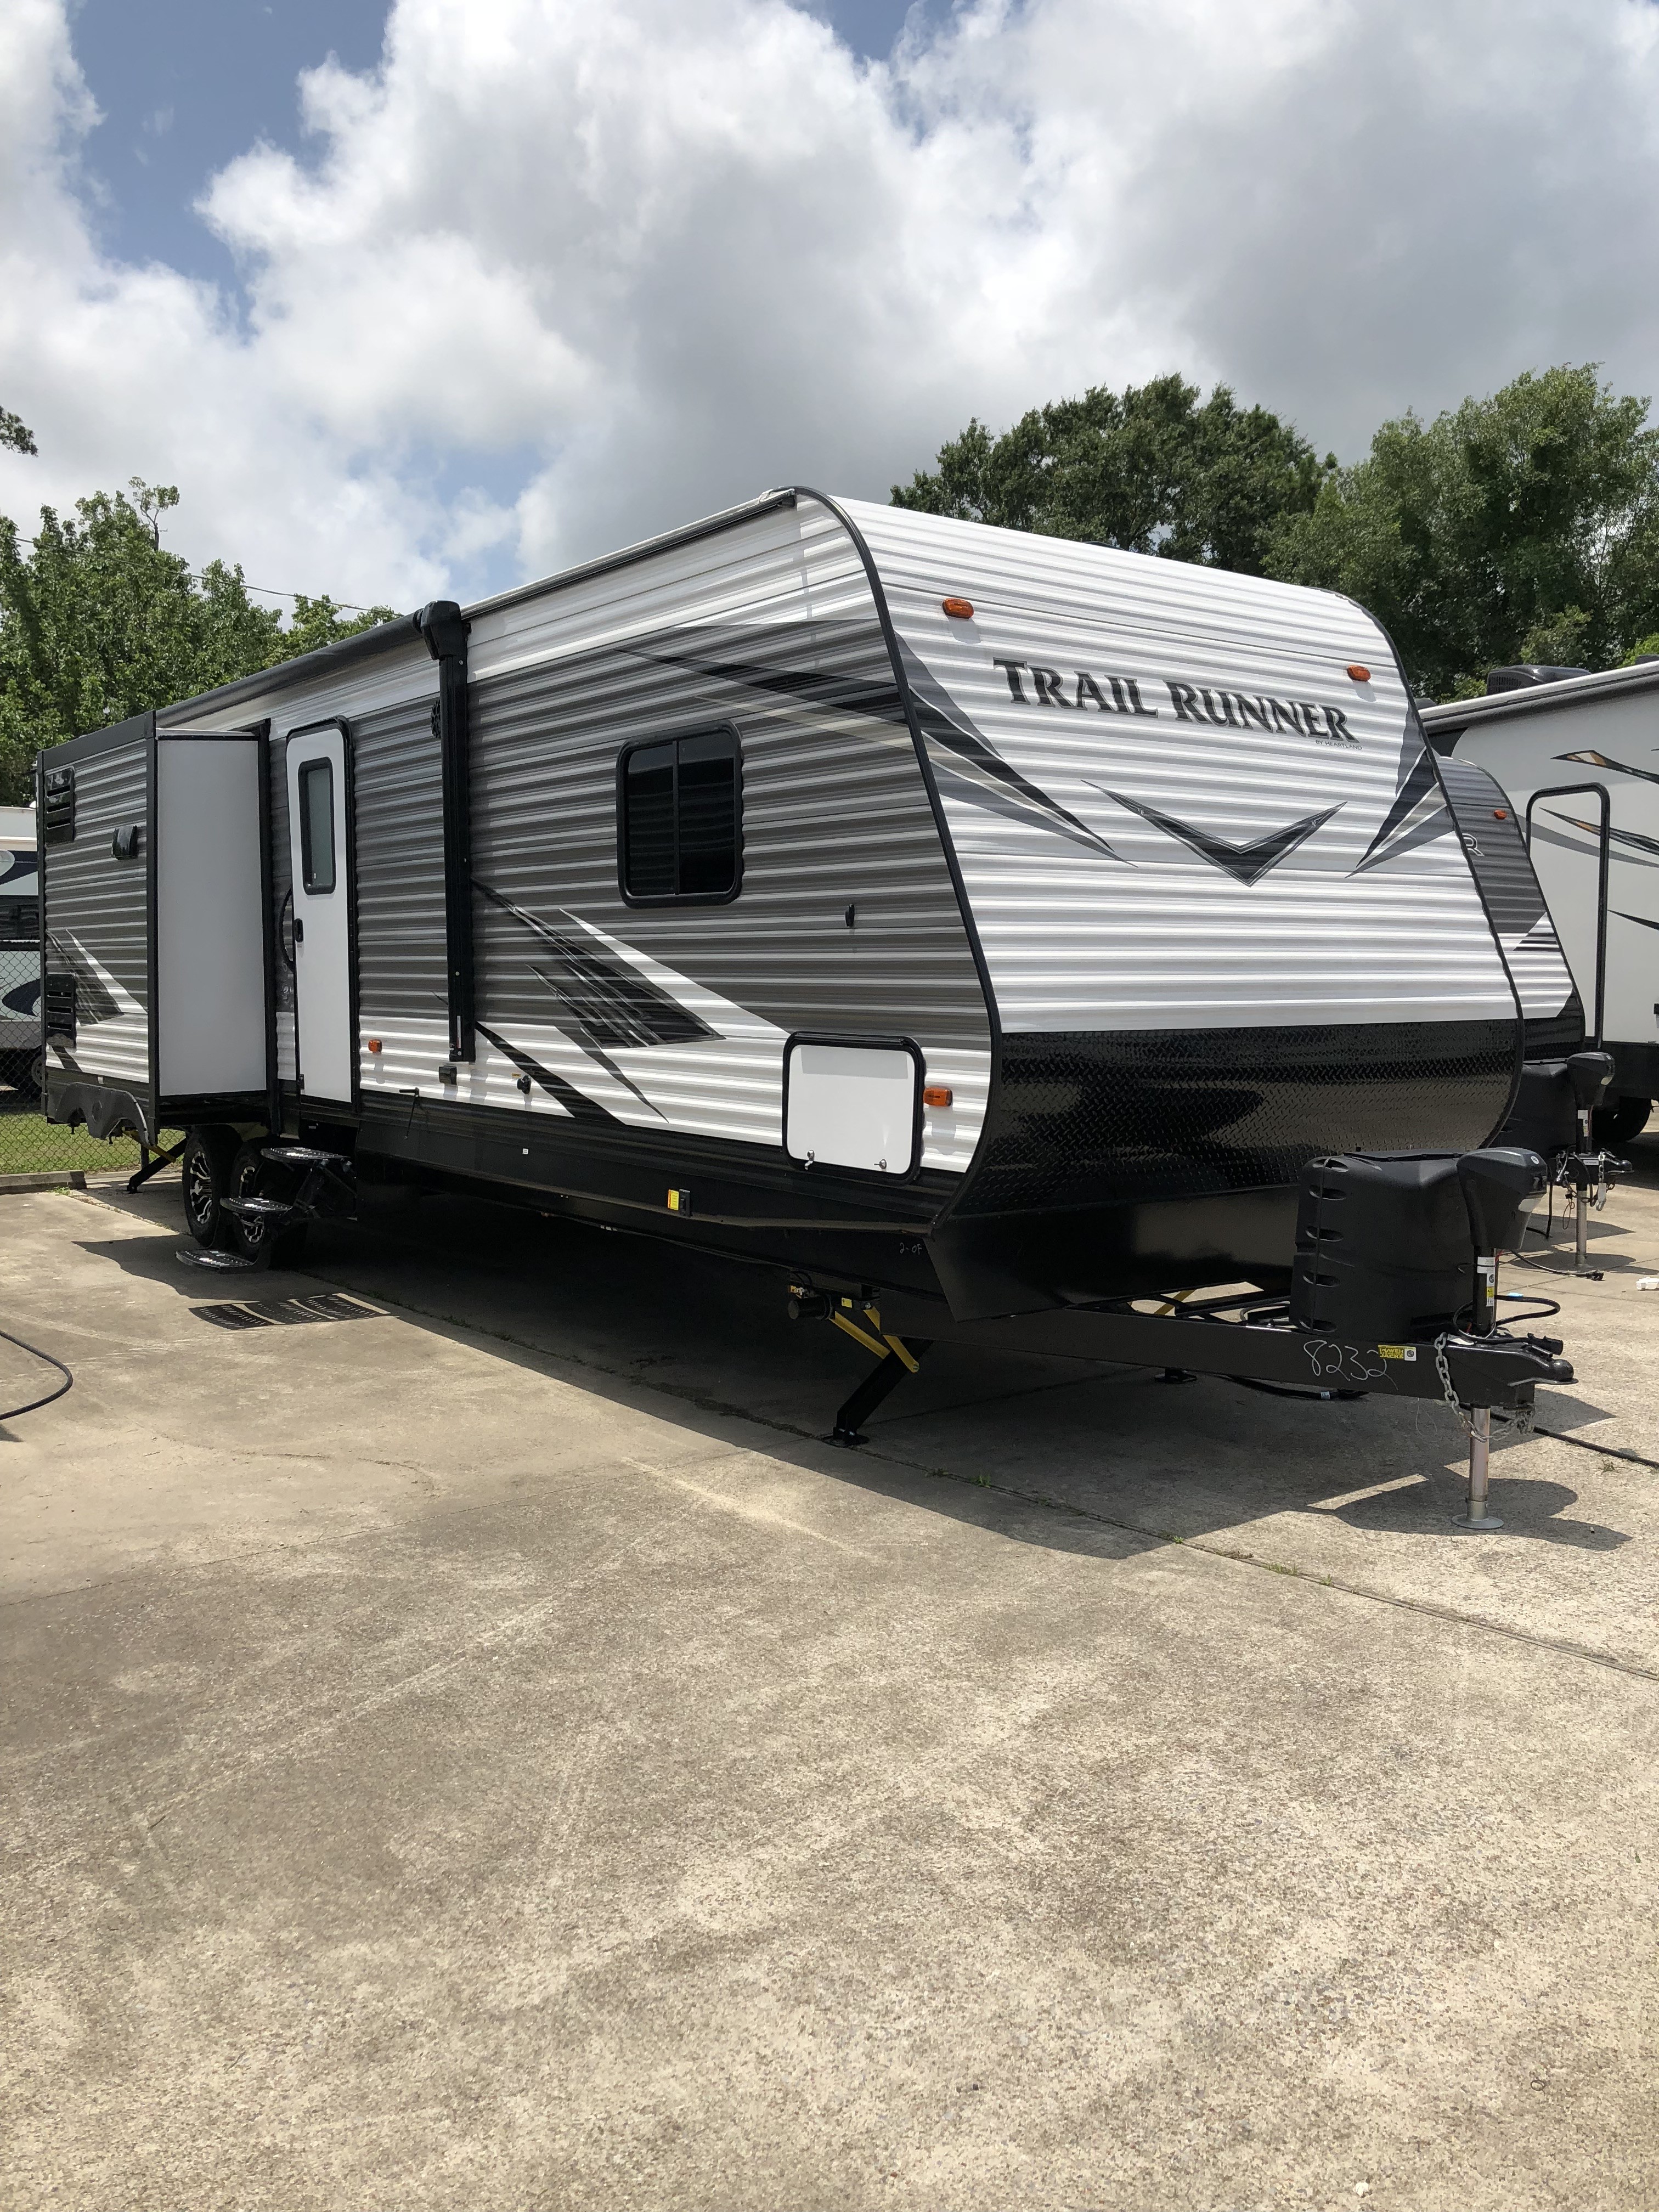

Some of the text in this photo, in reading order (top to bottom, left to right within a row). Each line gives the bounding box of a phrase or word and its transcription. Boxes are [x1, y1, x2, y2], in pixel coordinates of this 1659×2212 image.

[992, 657, 1361, 743] TRAIL RUNNER
[1325, 741, 1363, 751] HEARTLAND
